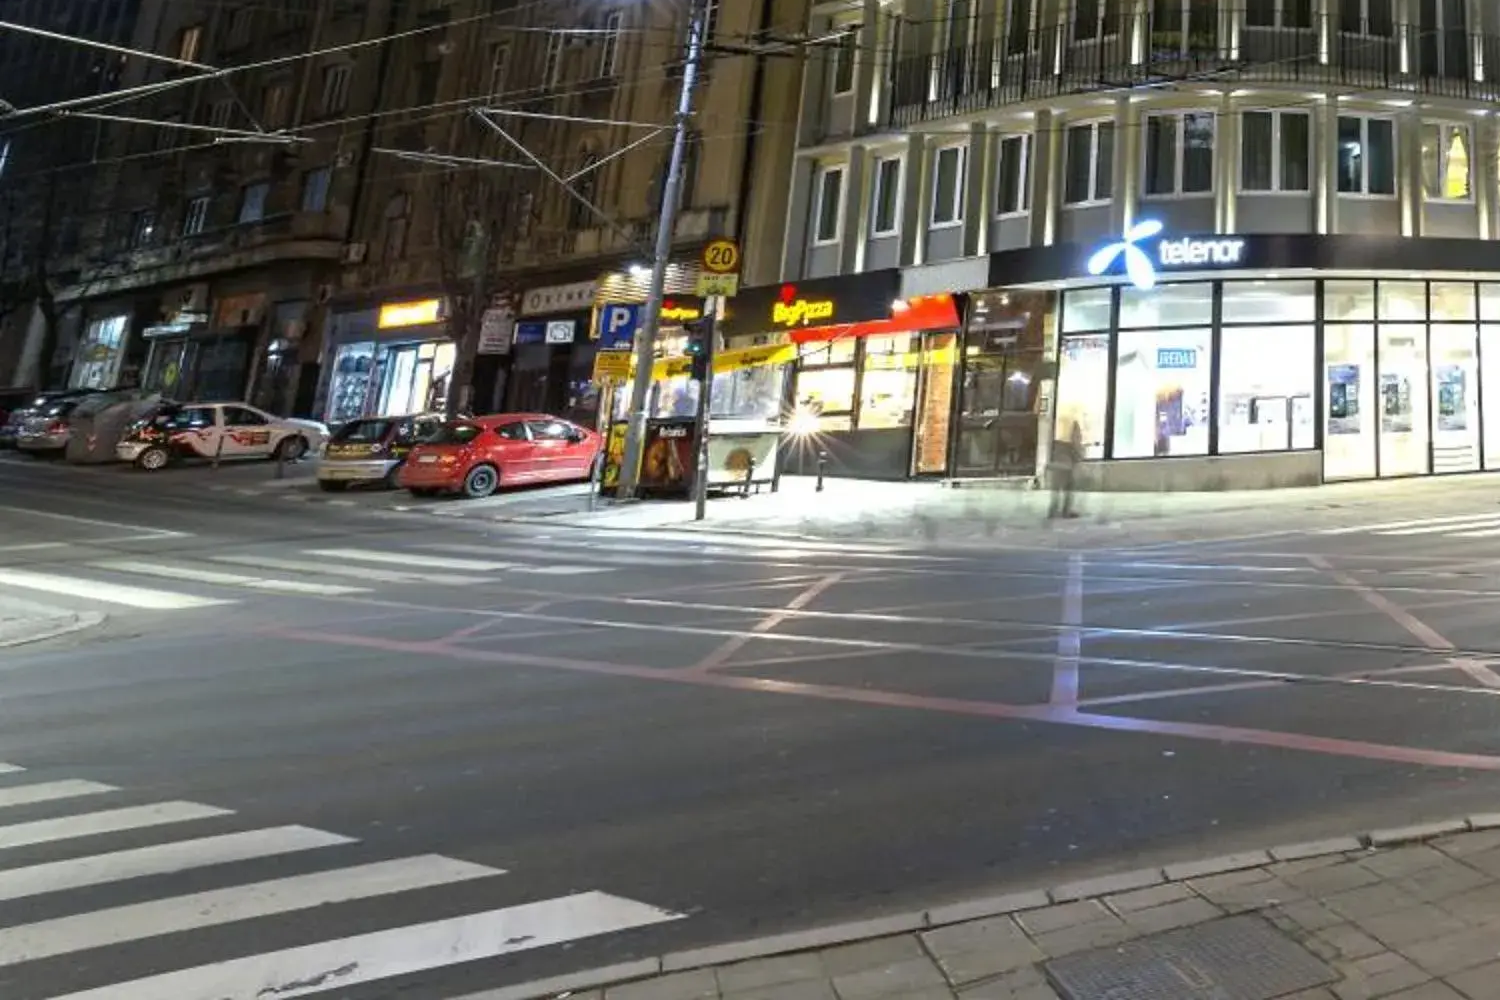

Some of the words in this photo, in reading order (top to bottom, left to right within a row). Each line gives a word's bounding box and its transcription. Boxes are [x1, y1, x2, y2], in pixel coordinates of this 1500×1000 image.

[709, 246, 733, 265] 20
[1159, 238, 1245, 264] telenor
[609, 308, 630, 333] P
